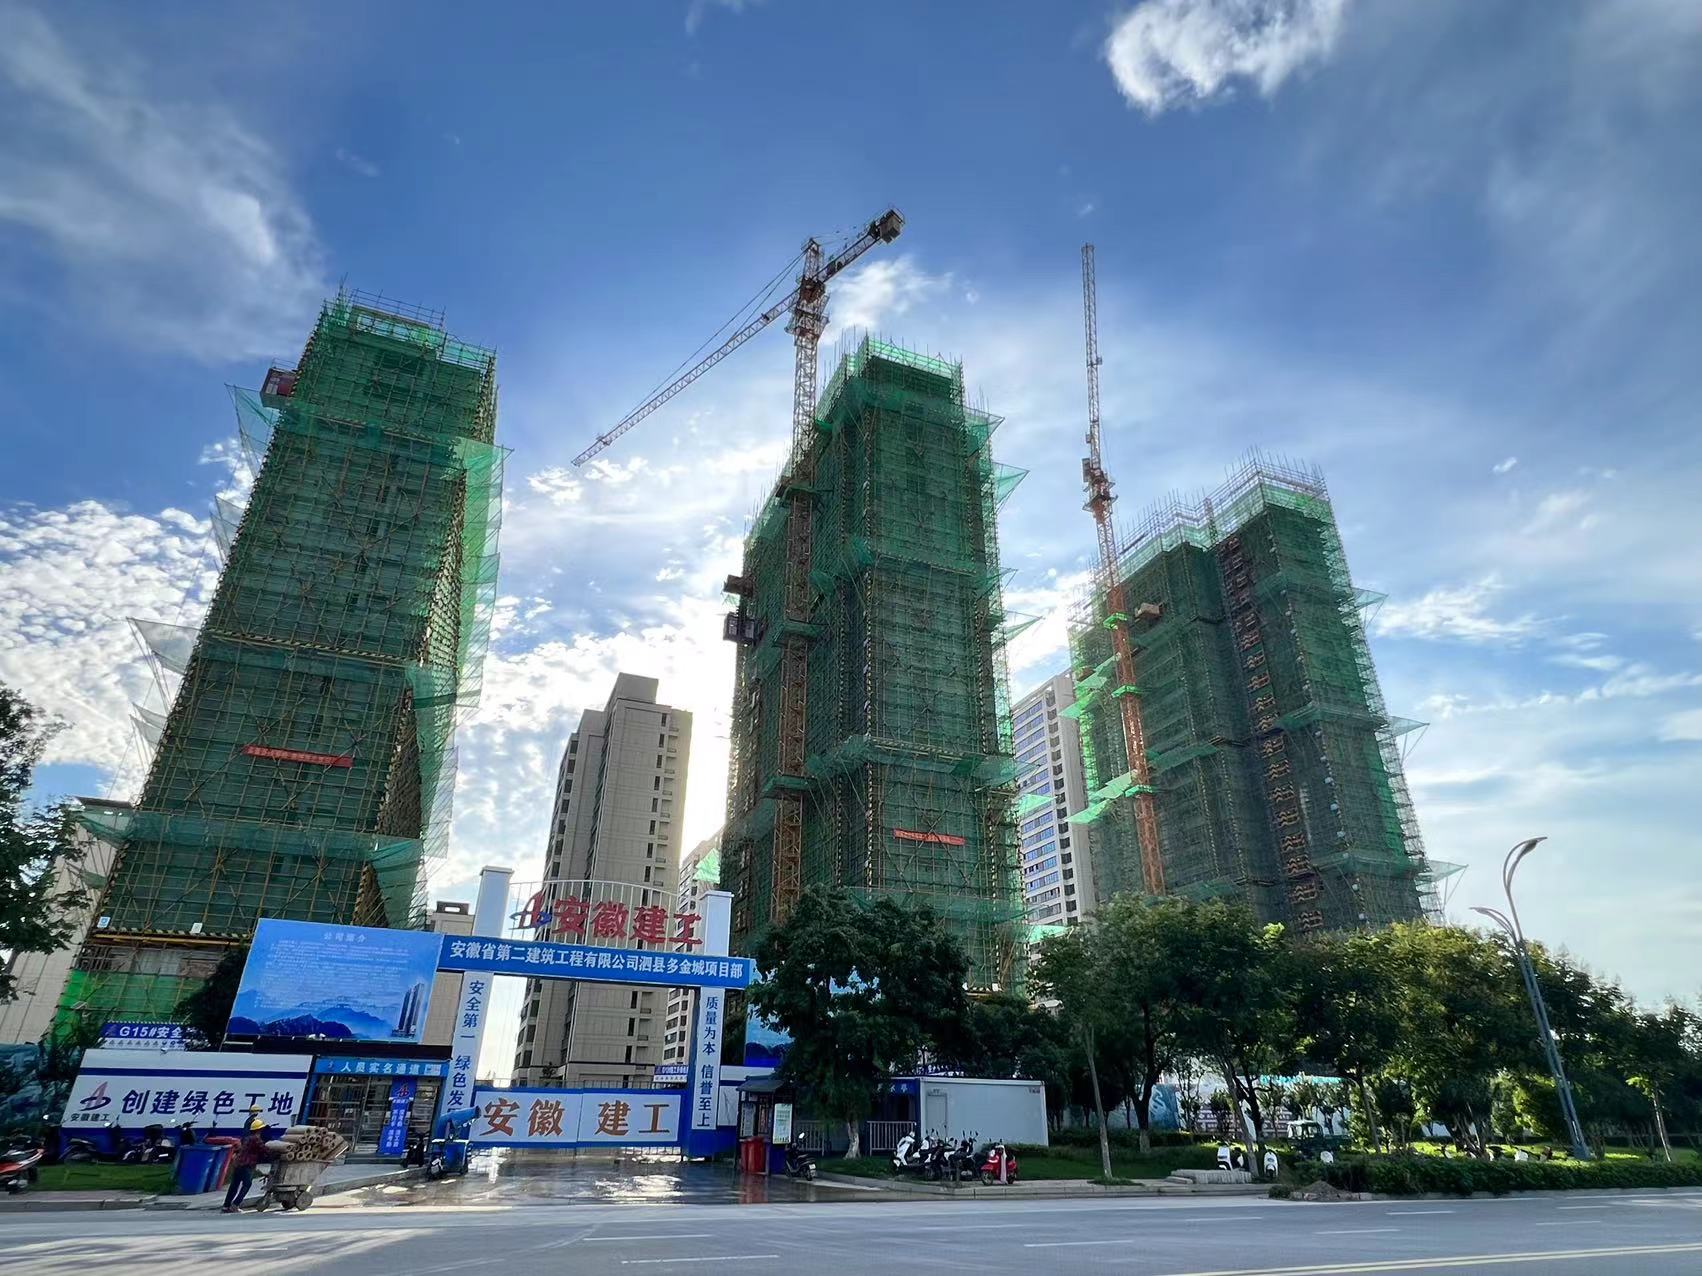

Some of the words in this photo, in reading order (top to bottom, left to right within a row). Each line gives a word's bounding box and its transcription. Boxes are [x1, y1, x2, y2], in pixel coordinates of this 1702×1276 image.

[551, 895, 703, 944] 安徽建工
[450, 941, 744, 978] 安徽省第二建筑工程有限公司泗县多金城项目部
[460, 980, 485, 1039] 安全第一
[703, 997, 719, 1055] 质量为本
[122, 1089, 294, 1116] 创建绿色工地
[447, 1055, 471, 1109] 绿色发
[697, 1065, 714, 1127] 信誉至上
[70, 1113, 109, 1122] 安徽建工
[479, 1098, 670, 1136] 安徽建工
